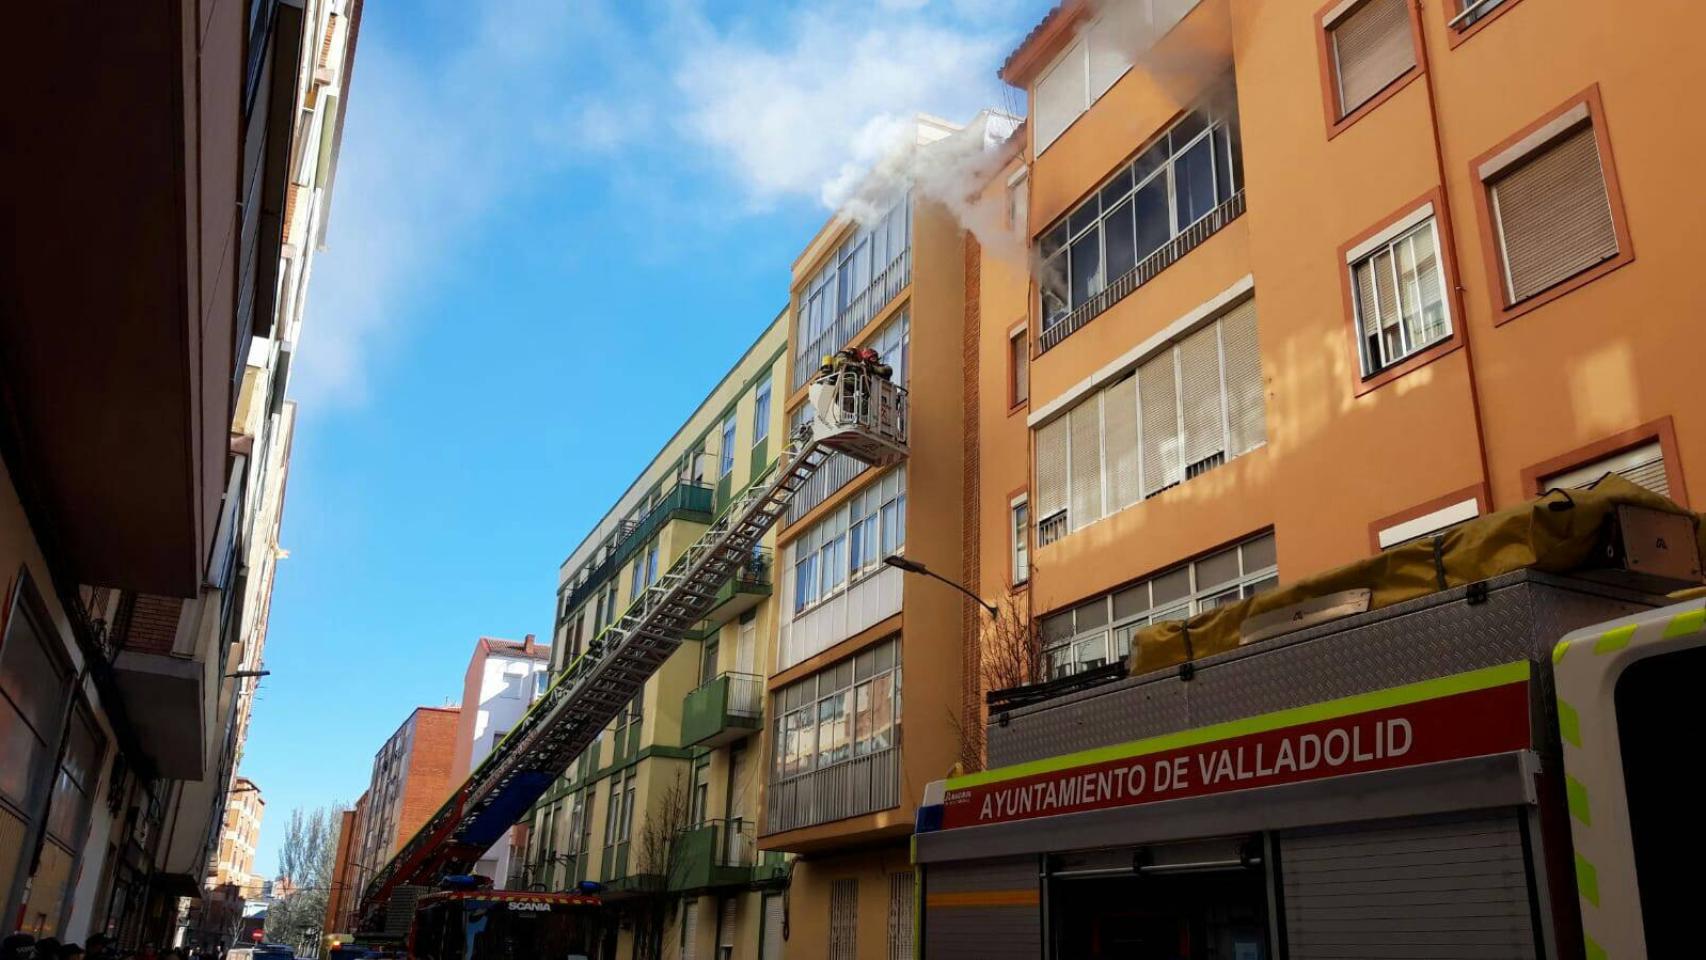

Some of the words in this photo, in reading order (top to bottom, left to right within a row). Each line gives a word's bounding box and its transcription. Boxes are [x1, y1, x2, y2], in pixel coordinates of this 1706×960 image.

[979, 764, 1146, 819] AYUNTAMIENTO
[1153, 756, 1190, 793] DE
[1198, 718, 1413, 786] VALLADOLID
[509, 902, 551, 912] SCANIA
